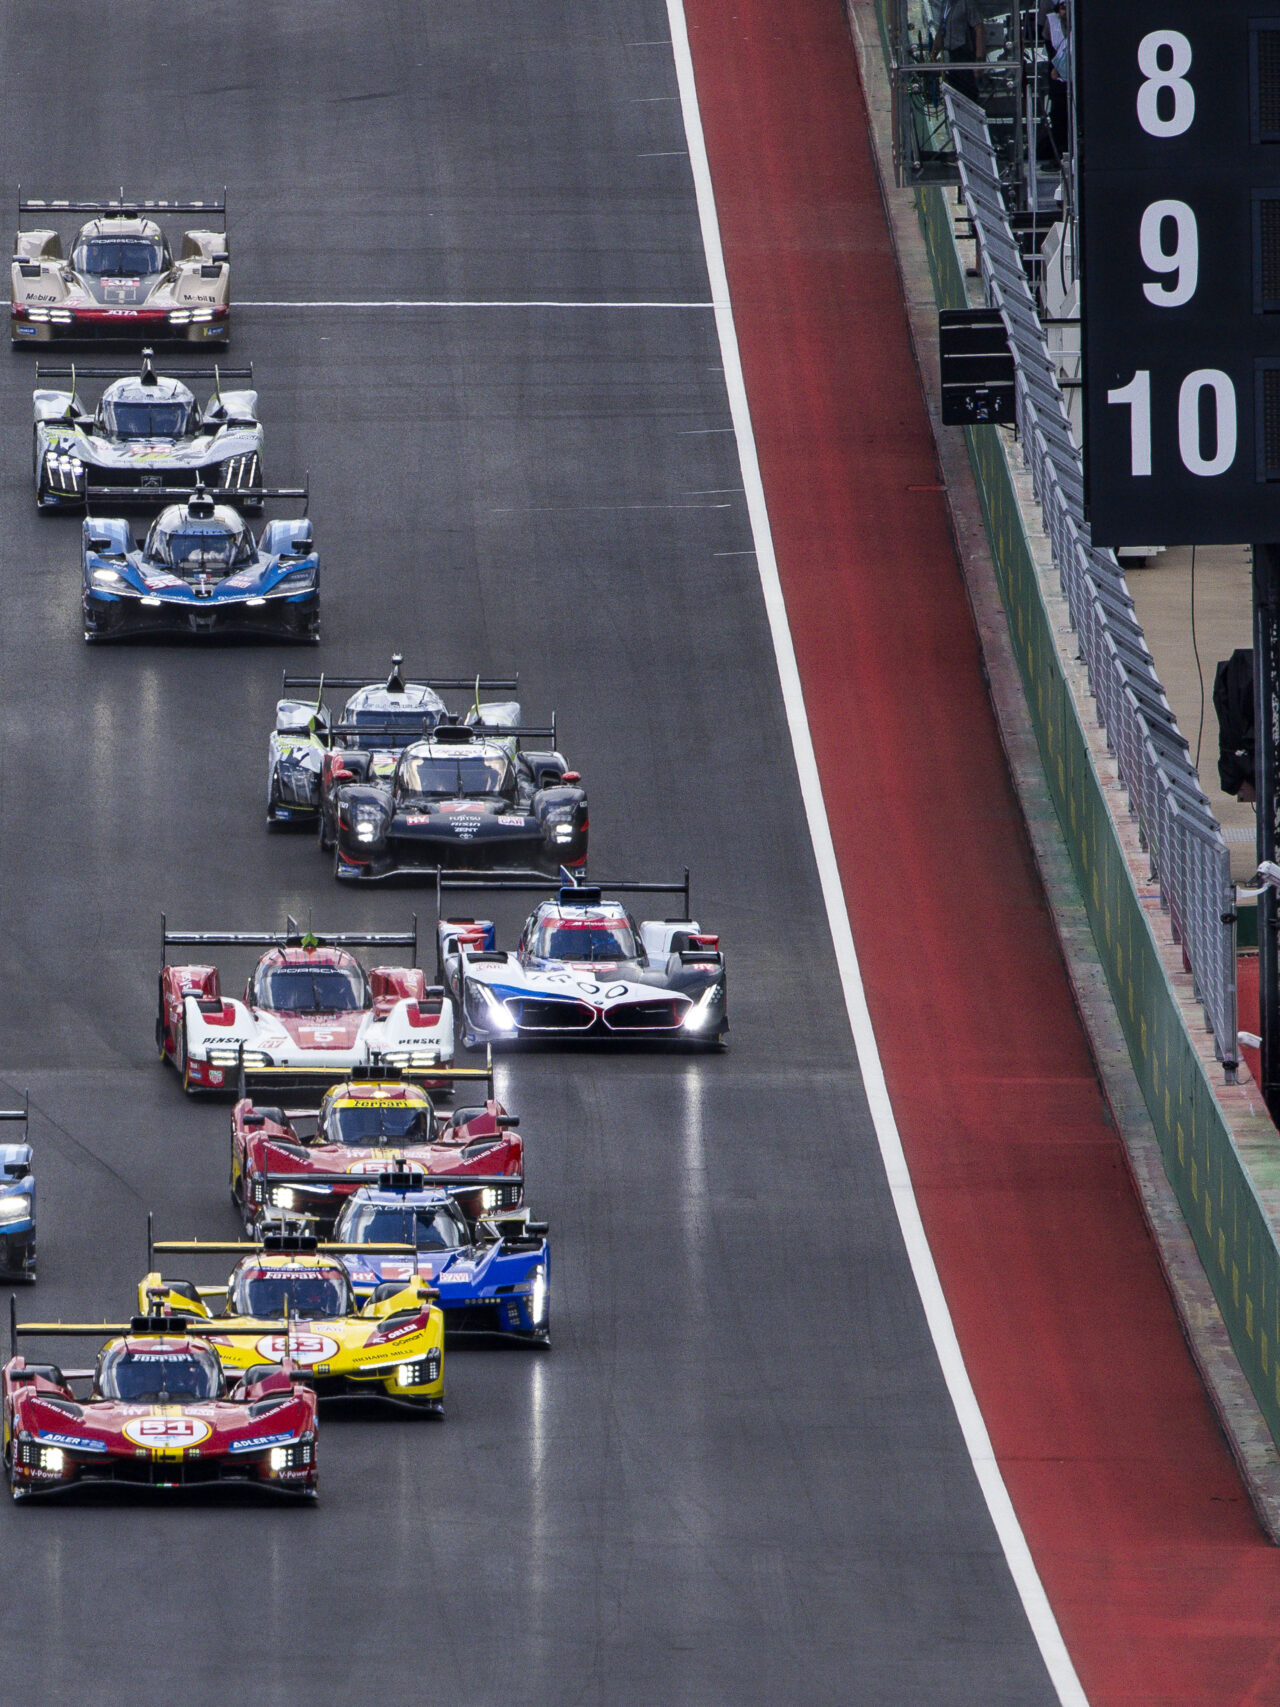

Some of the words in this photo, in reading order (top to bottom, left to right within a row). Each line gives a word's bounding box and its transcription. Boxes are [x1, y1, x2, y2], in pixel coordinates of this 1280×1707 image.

[1137, 29, 1195, 138] 8
[1139, 199, 1199, 308] 9
[1107, 368, 1237, 477] 10
[454, 804, 471, 812] 7
[313, 1032, 335, 1043] 5
[398, 1038, 441, 1046] PENSKE
[354, 1099, 408, 1108] Ferrari
[264, 1271, 323, 1281] Ferrari
[351, 1272, 375, 1281] HY
[396, 1268, 414, 1280] 2
[131, 1353, 193, 1363] Ferrari
[142, 1420, 192, 1435] 51
[43, 1433, 81, 1445] ADLER
[233, 1437, 268, 1449] ADLER
[30, 1468, 63, 1479] V-Power
[278, 1468, 308, 1479] V-Power
